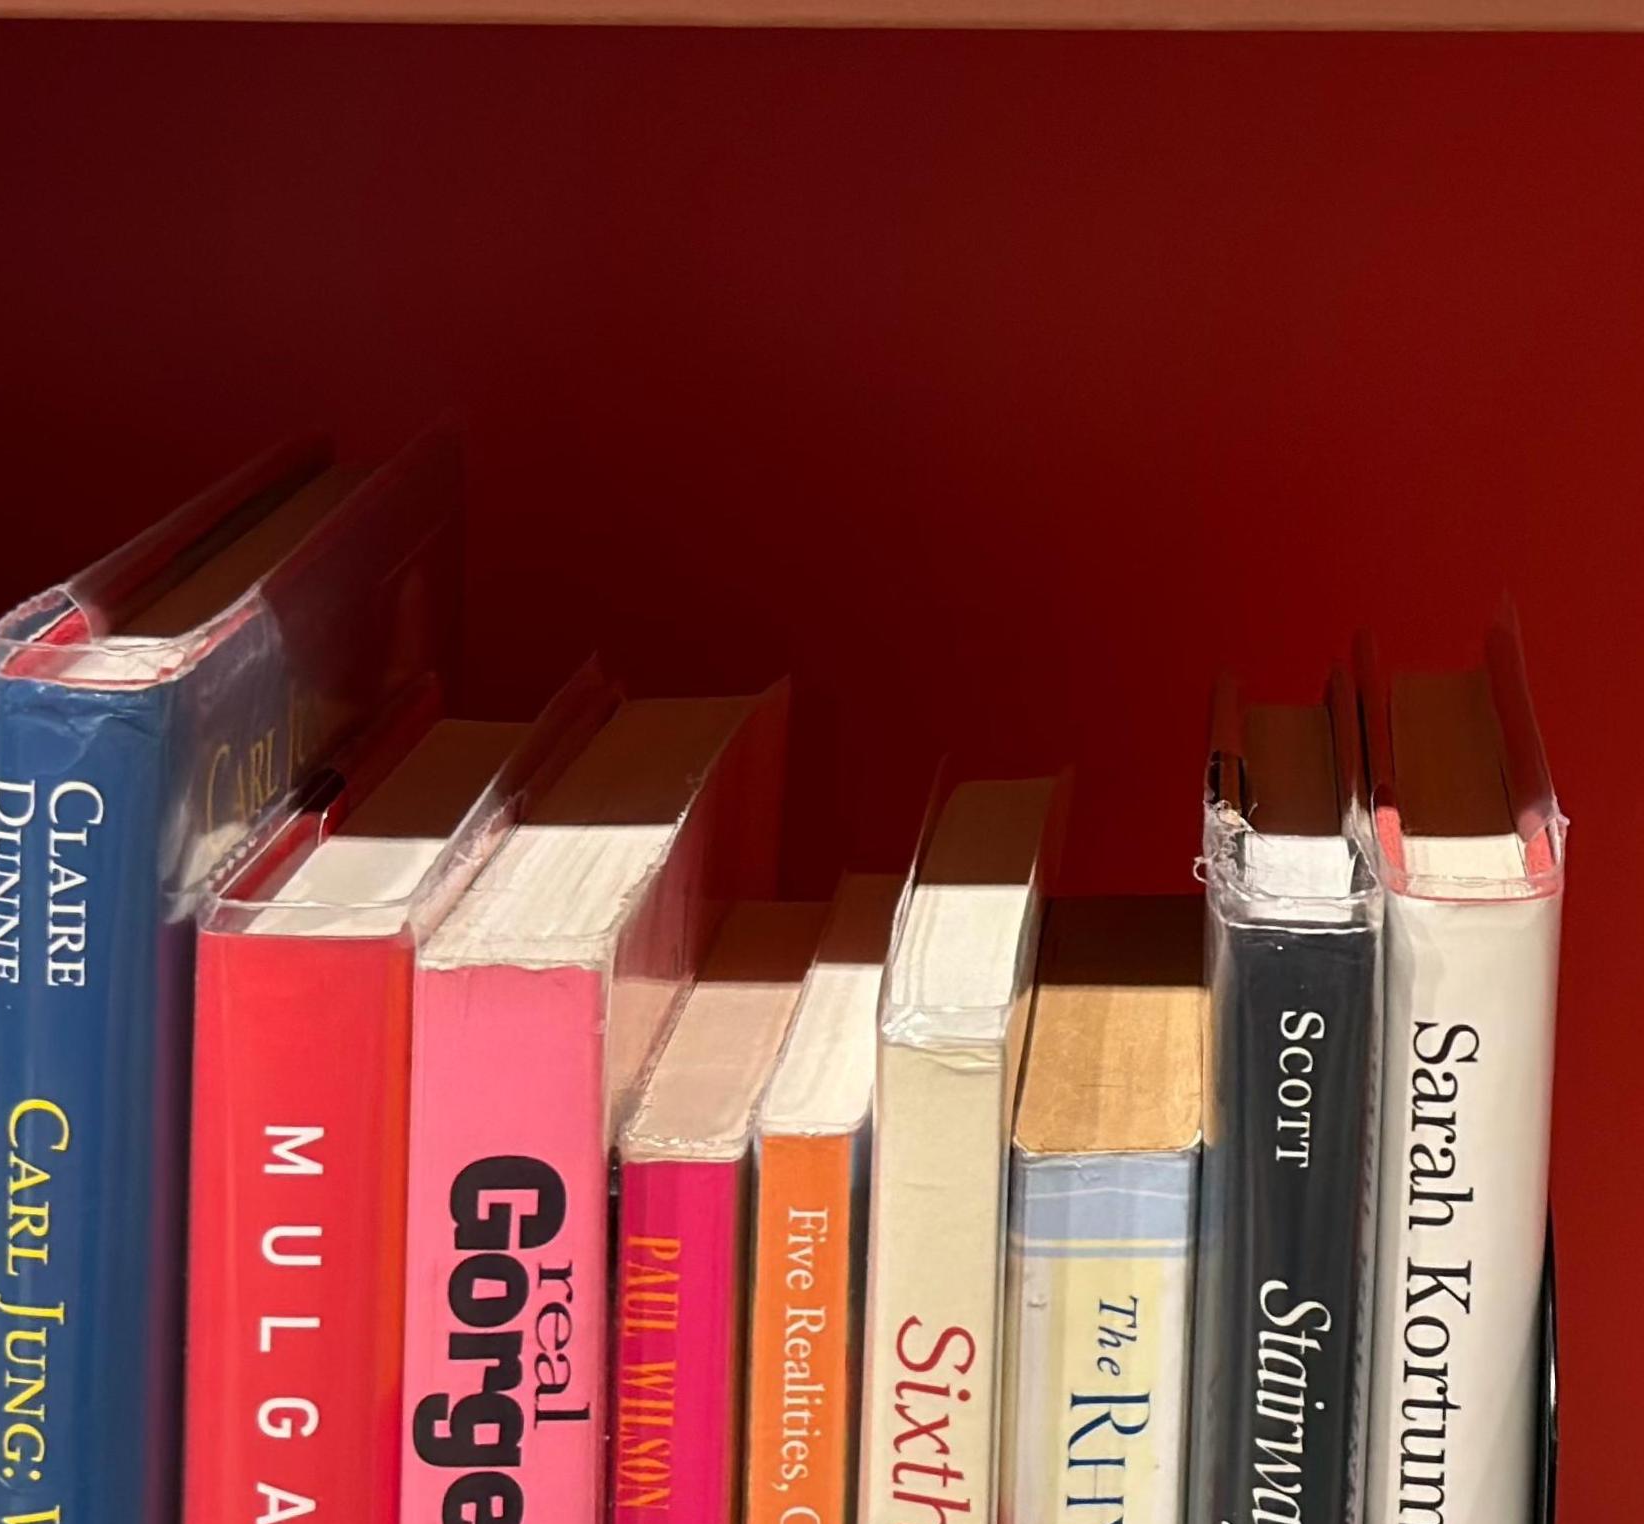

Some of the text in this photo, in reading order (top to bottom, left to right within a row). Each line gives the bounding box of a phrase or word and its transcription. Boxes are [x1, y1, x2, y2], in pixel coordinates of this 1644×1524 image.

[45, 781, 104, 988] CLAIRE
[7, 1099, 71, 1277] CARL
[1407, 1020, 1481, 1231] Sarah
[785, 1206, 829, 1291] Five
[1098, 1295, 1138, 1377] The
[533, 1259, 591, 1433] real
[617, 1235, 681, 1510] PAUL WILSON
[774, 1302, 825, 1492] Realities,
